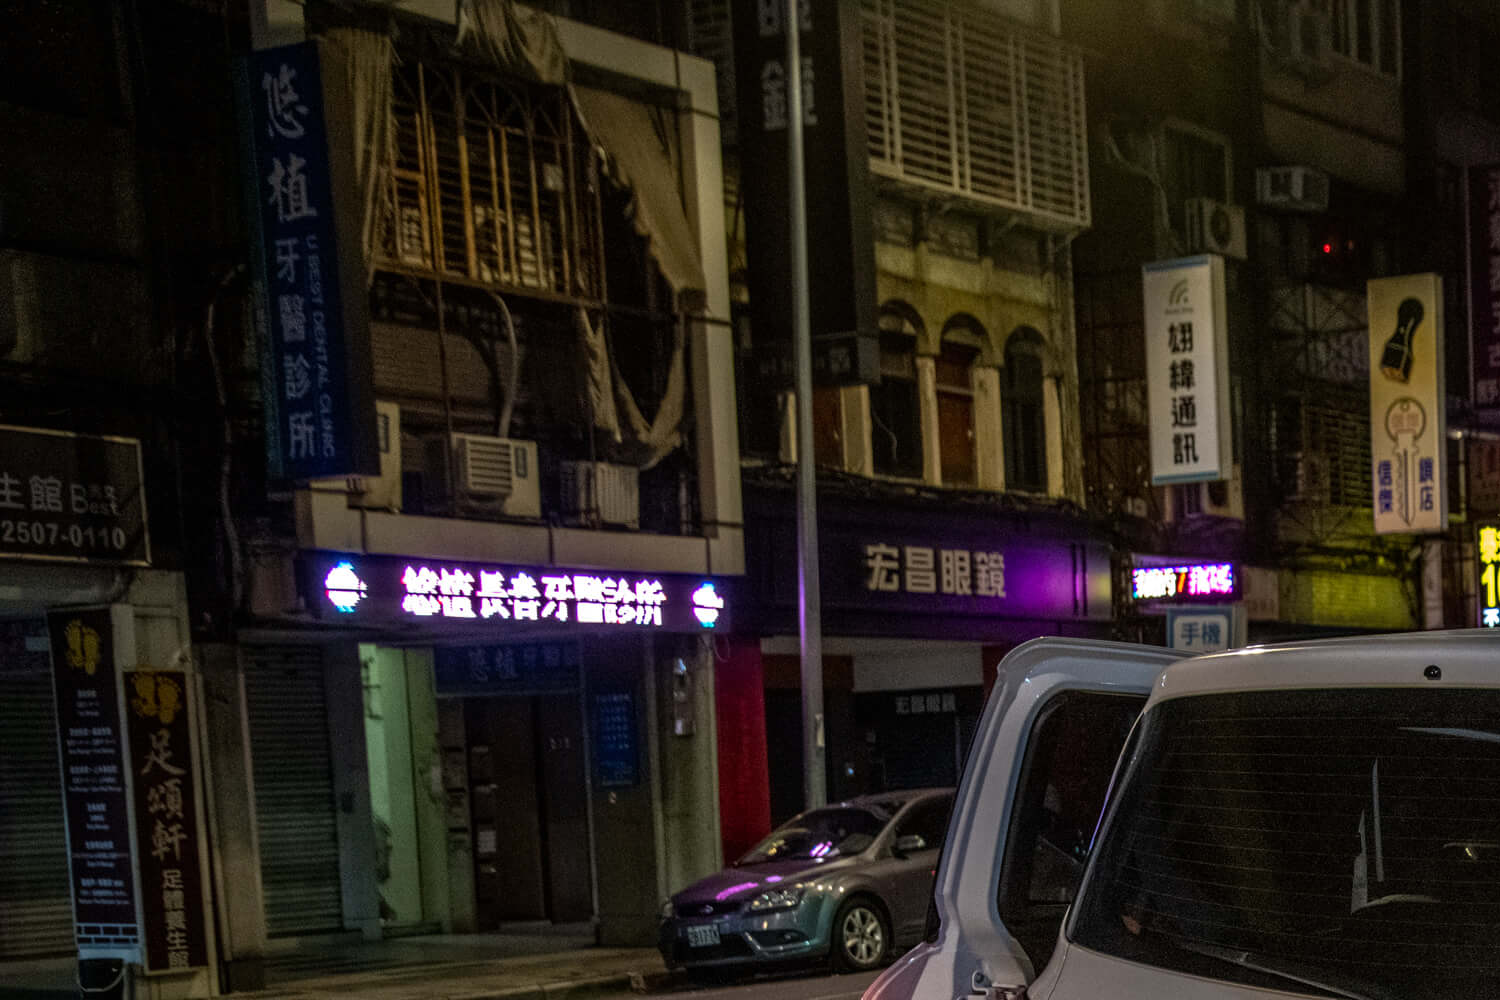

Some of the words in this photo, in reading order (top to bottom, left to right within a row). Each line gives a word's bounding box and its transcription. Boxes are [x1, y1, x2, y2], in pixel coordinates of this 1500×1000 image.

[0, 519, 126, 550] 2507-0110
[864, 543, 1006, 598] 宏昌眼鏡
[1181, 622, 1222, 647] 手機
